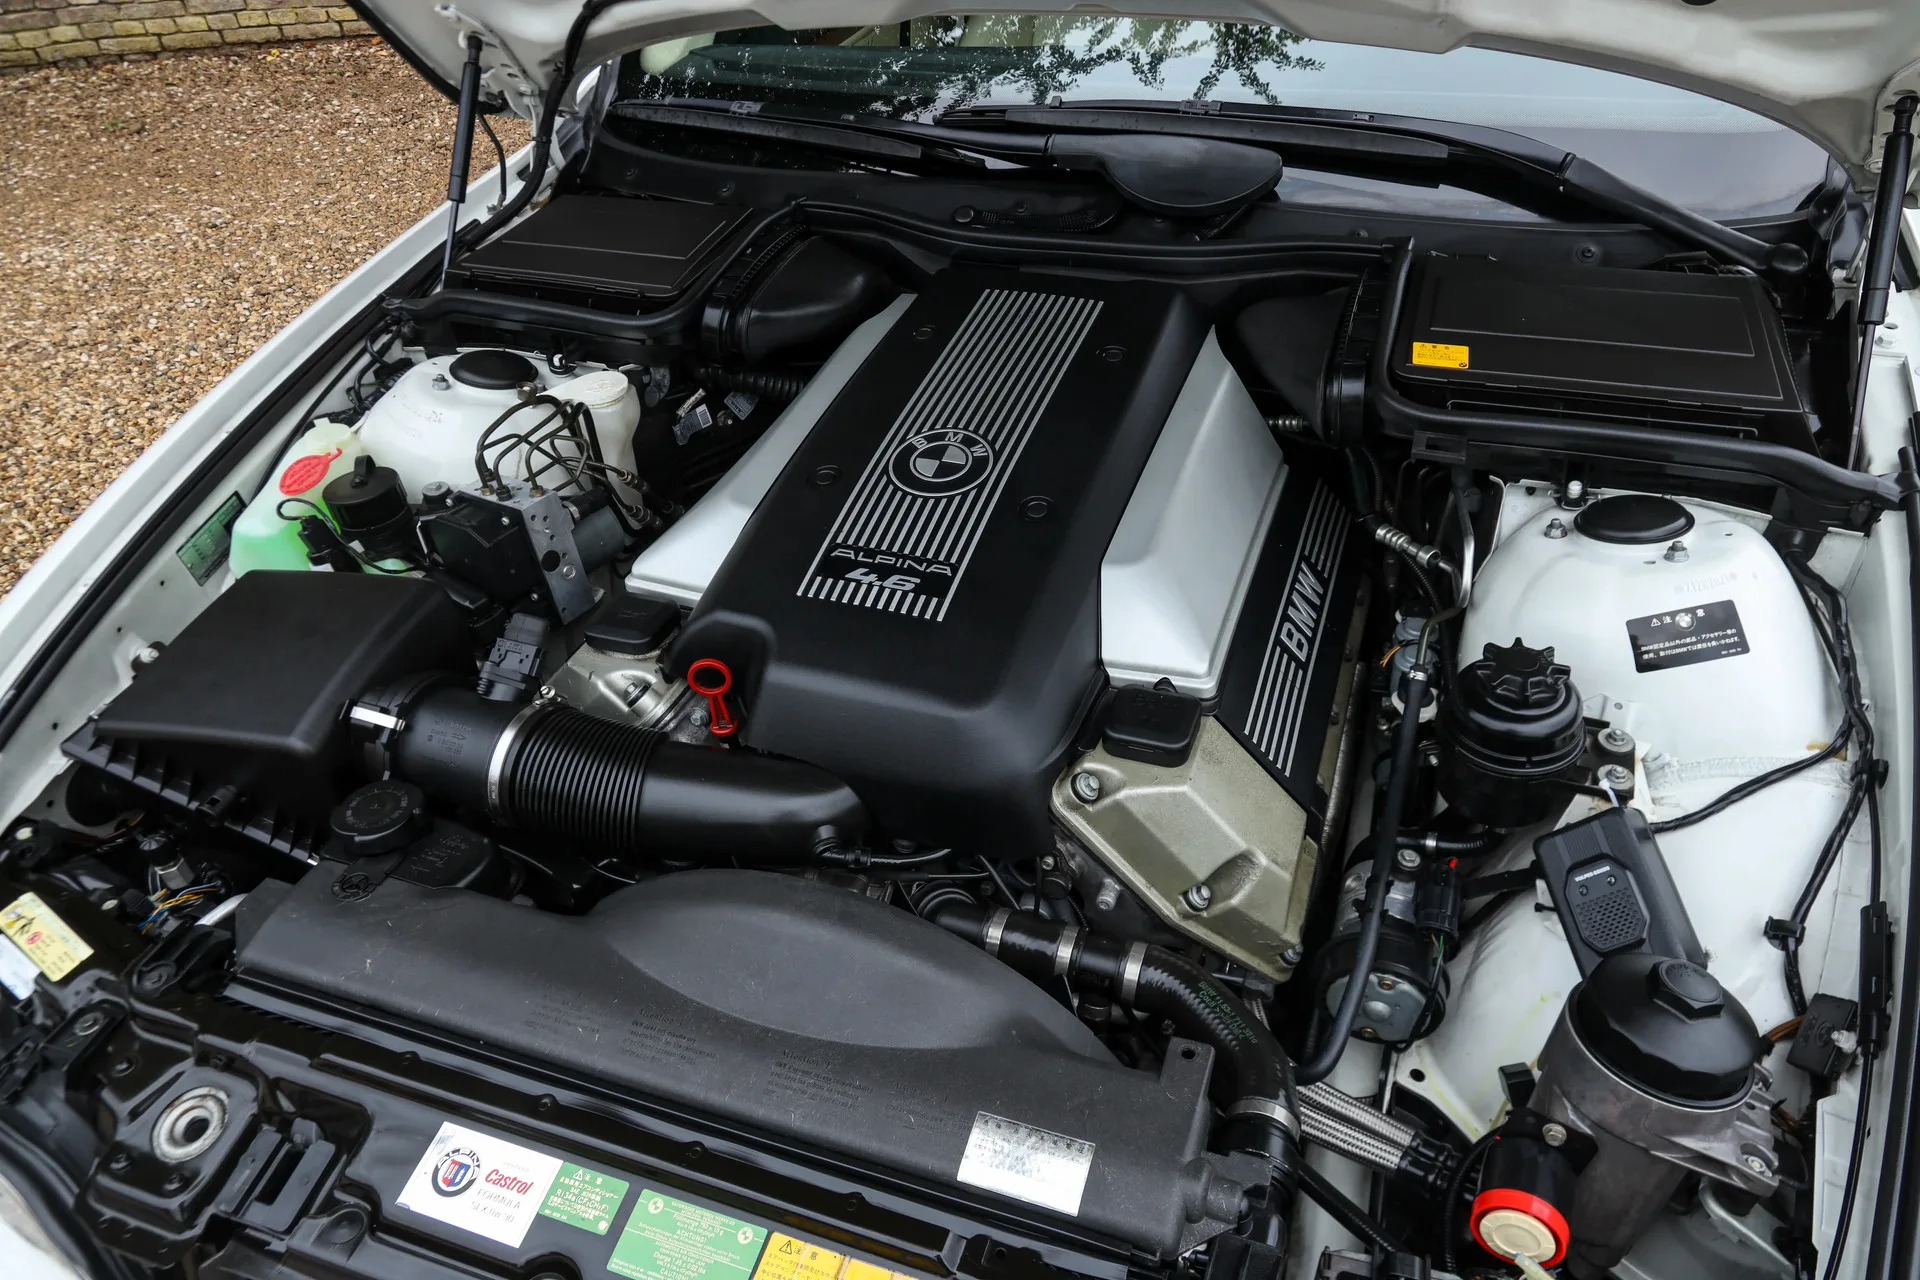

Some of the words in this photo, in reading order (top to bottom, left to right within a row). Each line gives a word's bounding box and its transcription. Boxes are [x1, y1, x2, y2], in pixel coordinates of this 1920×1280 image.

[911, 431, 988, 459] BMW
[830, 548, 952, 576] ALPINA
[845, 567, 921, 591] 4.6
[1280, 560, 1325, 663] BMW
[485, 1168, 534, 1195] Castrol
